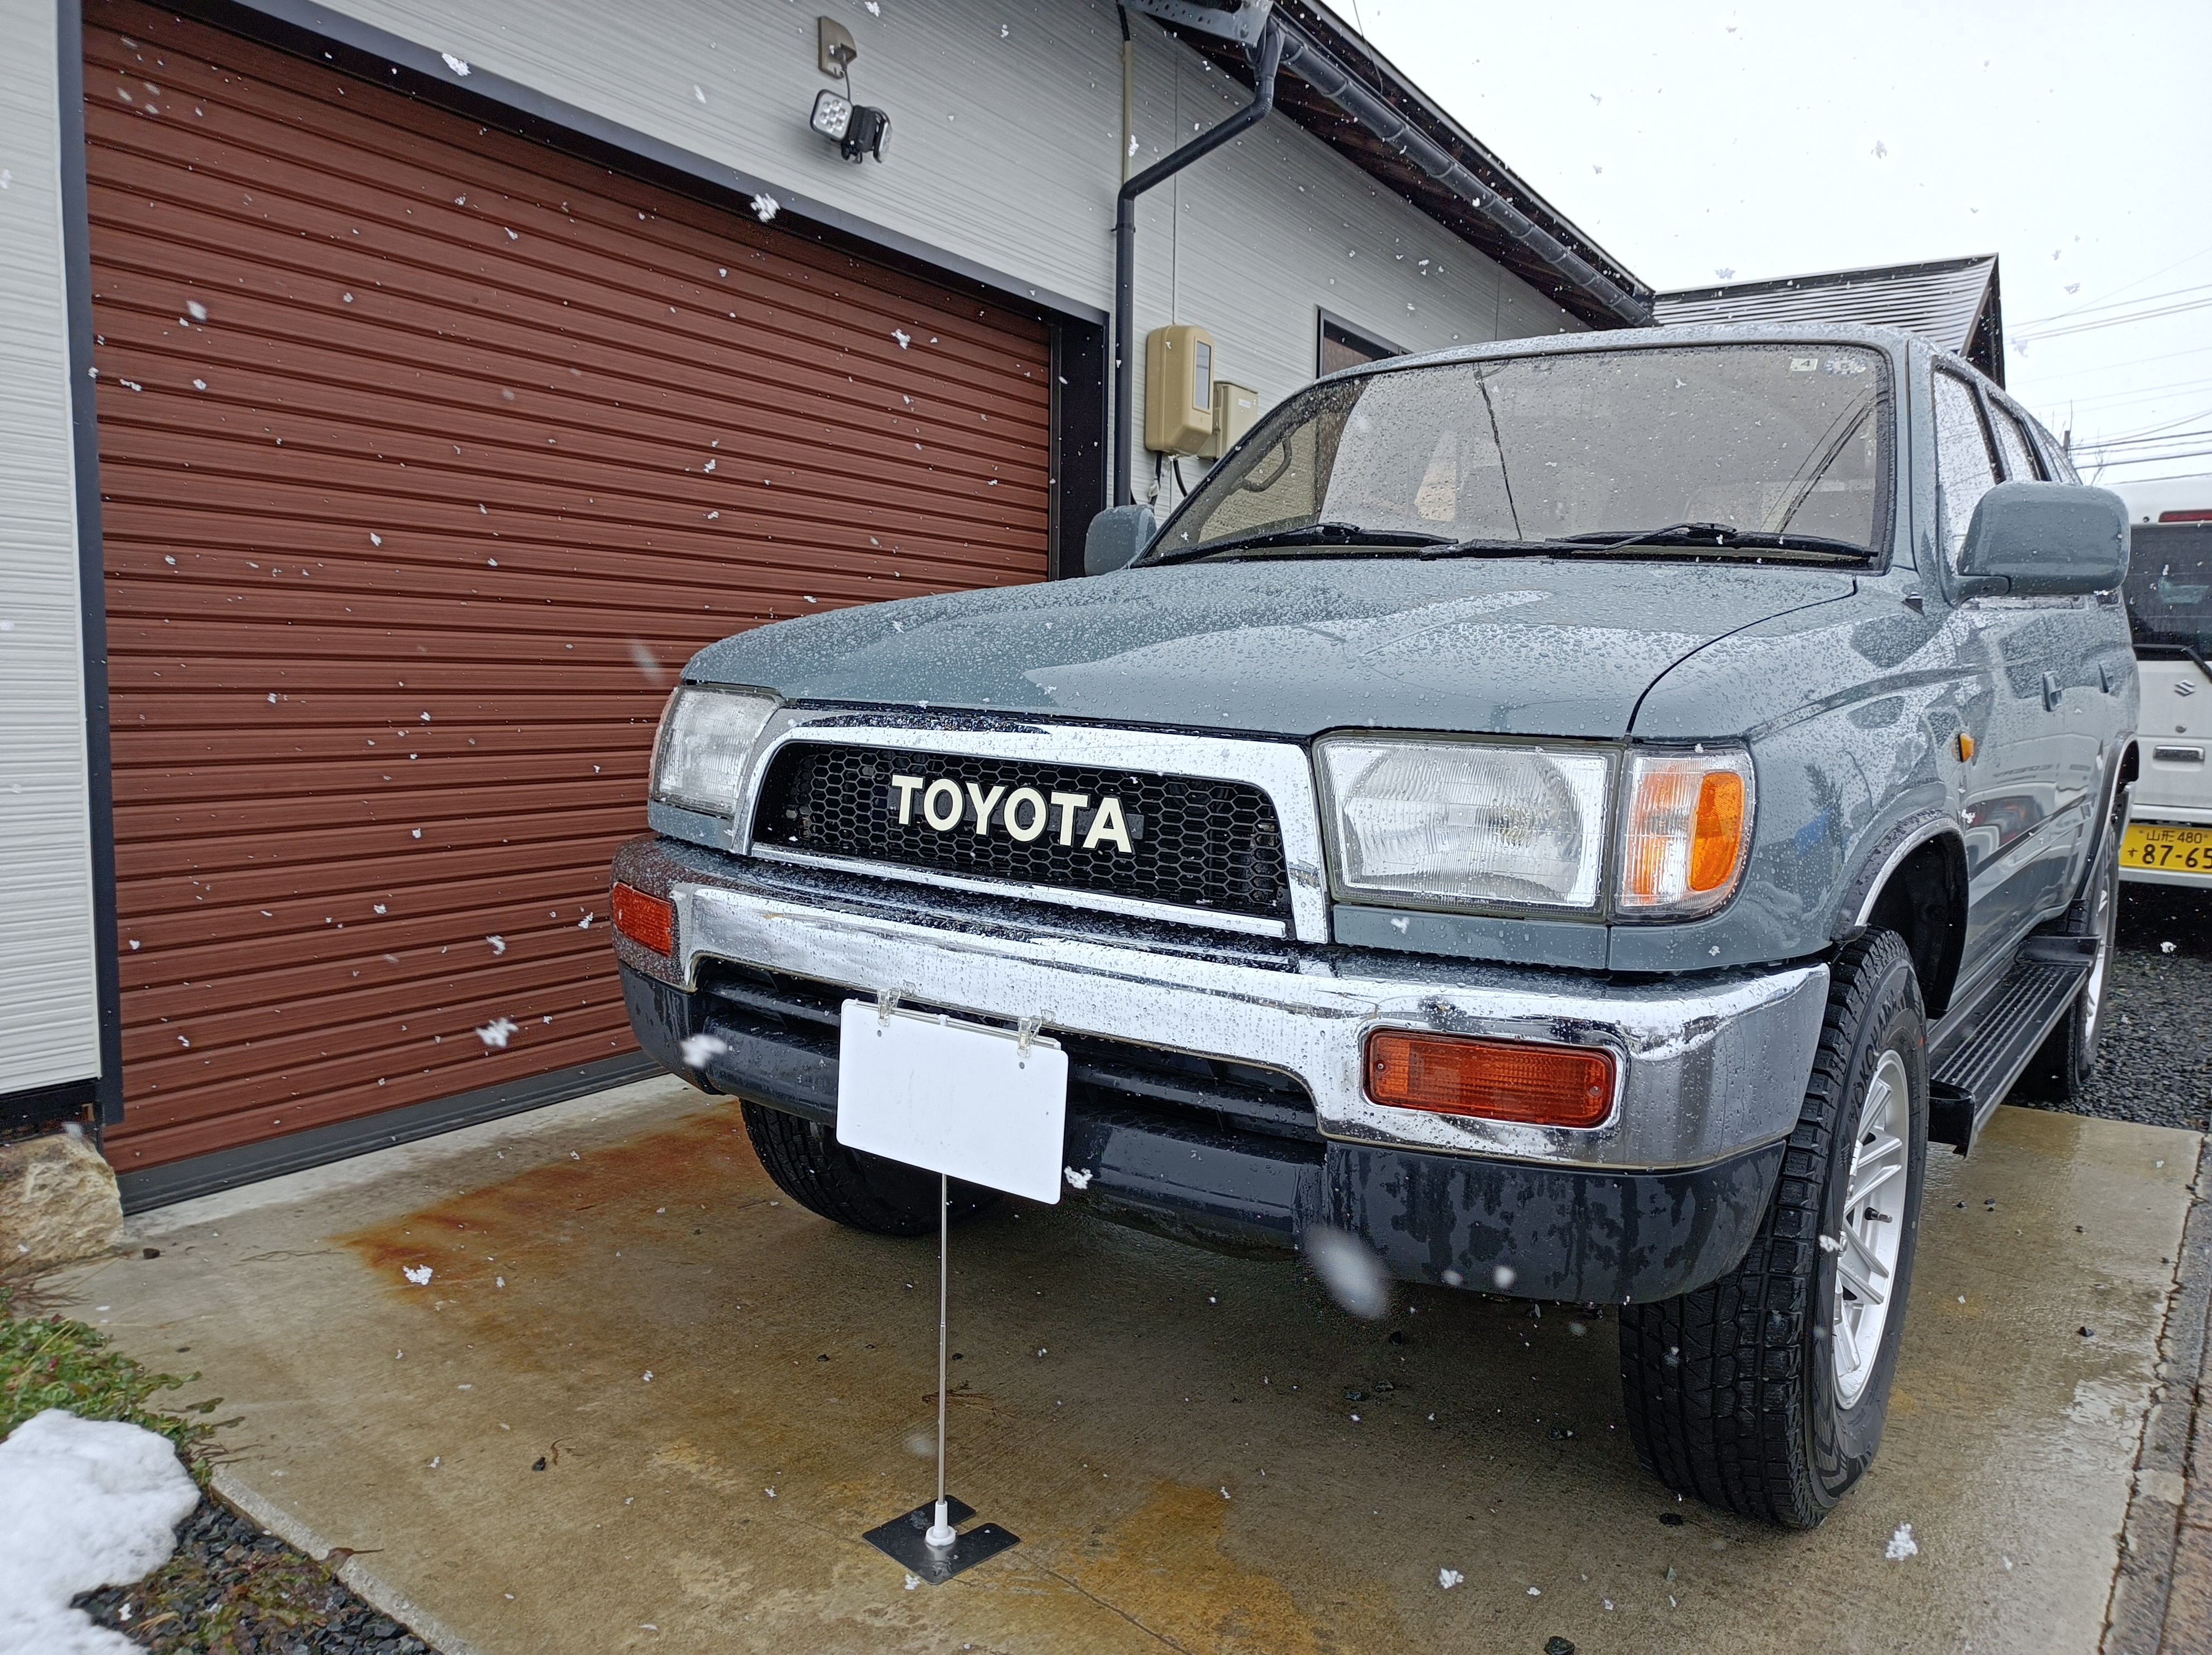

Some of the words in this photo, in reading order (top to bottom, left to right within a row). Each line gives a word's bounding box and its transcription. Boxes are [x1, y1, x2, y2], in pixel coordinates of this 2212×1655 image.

[891, 774, 1133, 853] TOYOTA
[2127, 847, 2138, 858] す
[2146, 830, 2176, 842] 山形
[2177, 831, 2203, 844] 480
[1848, 989, 1897, 1124] YOKOHAMA
